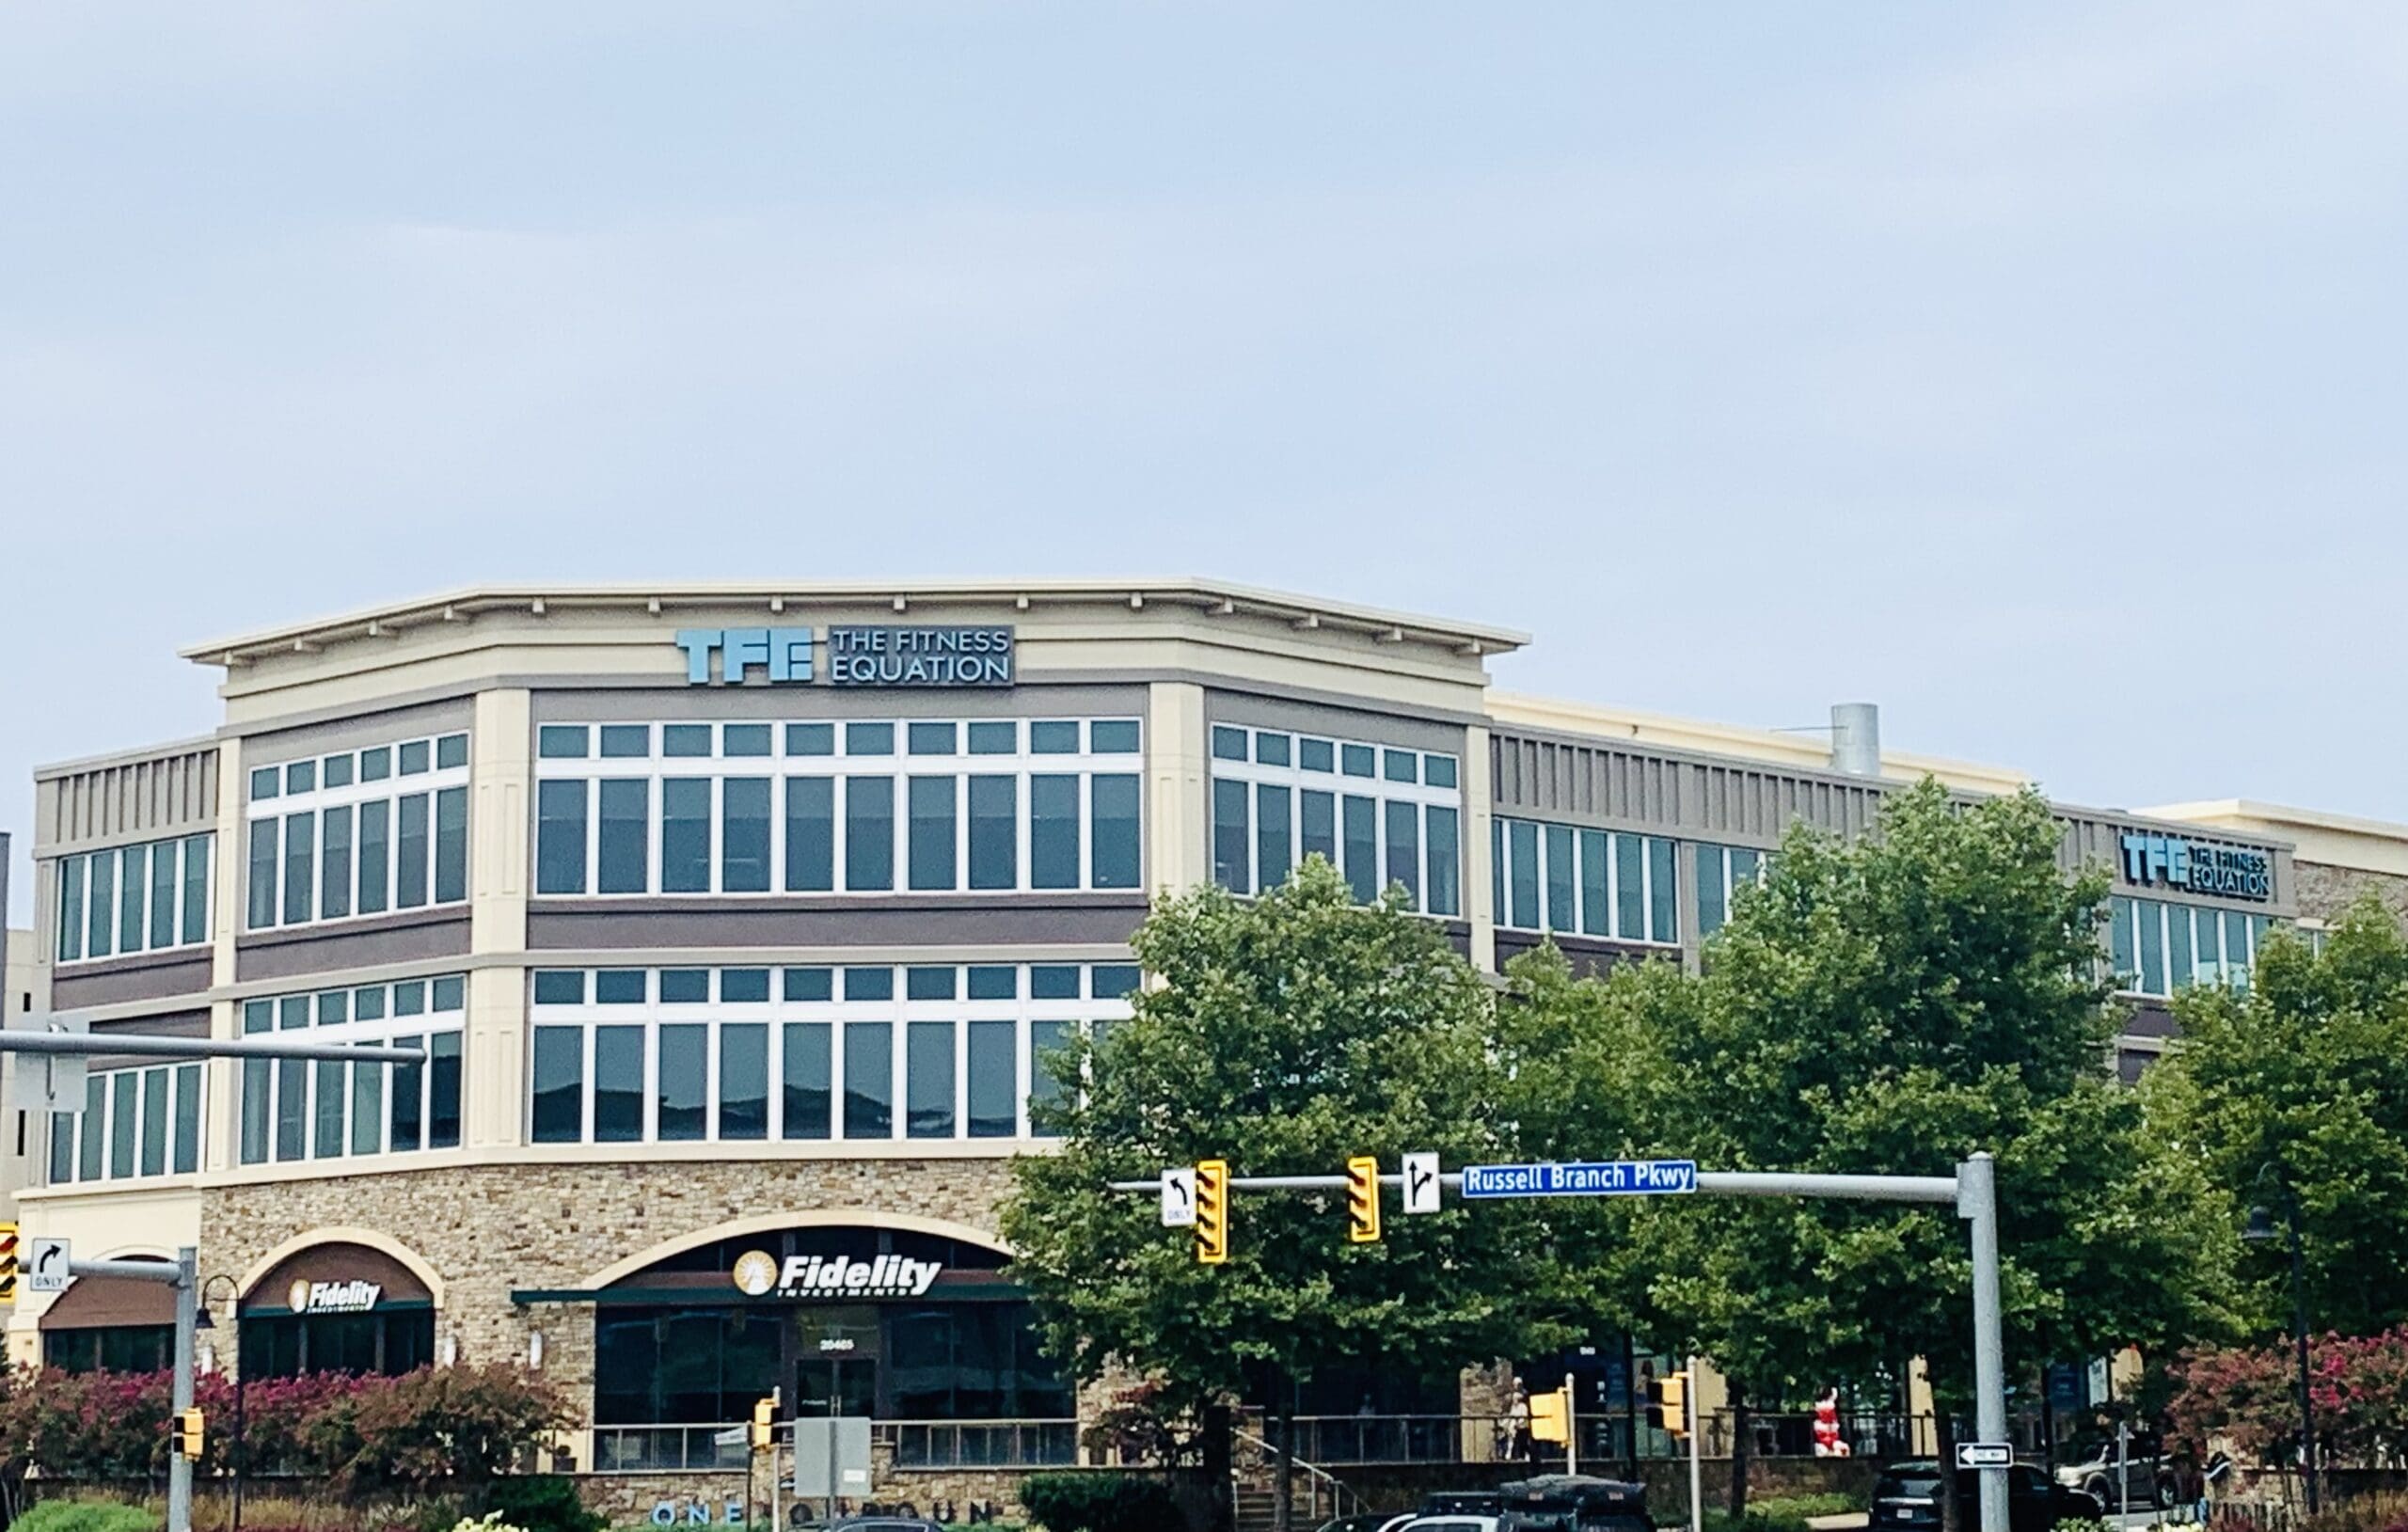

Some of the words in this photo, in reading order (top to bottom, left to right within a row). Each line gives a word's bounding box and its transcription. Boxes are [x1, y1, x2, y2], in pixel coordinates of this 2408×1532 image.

[833, 630, 886, 652] THE
[896, 630, 1009, 653] FITNESS
[676, 629, 814, 685] TFE
[832, 655, 1009, 682] EQUATION
[2122, 835, 2188, 882] TFE
[2190, 865, 2269, 895] EQUATION
[1468, 1167, 1543, 1191] Russell
[1551, 1165, 1625, 1189] Branch
[1634, 1164, 1690, 1191] Pkwy
[35, 1276, 62, 1287] ONLY
[778, 1255, 942, 1296] Fidelity
[309, 1280, 380, 1311] Fidelity
[651, 1503, 744, 1526] ONE
